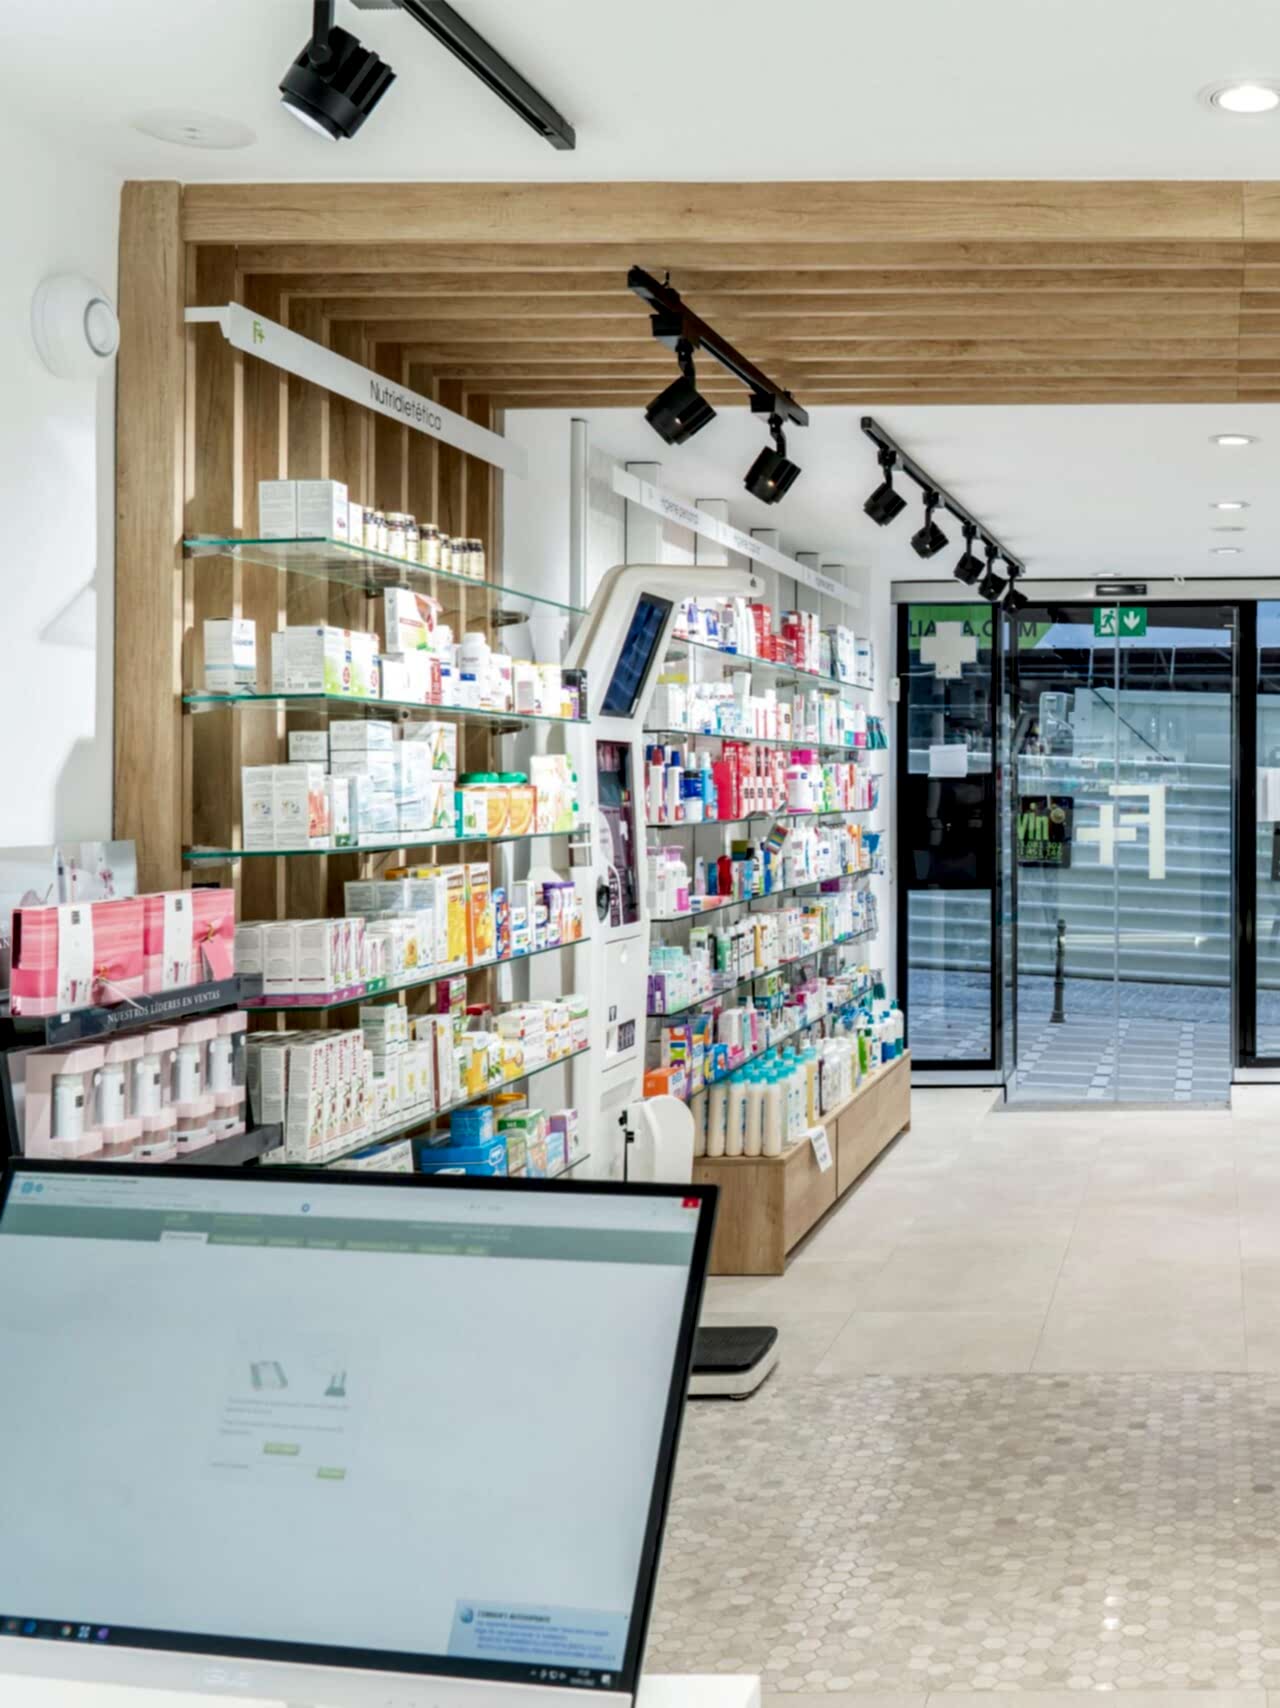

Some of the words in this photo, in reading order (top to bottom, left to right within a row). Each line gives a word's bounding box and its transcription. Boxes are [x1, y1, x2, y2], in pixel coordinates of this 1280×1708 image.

[369, 379, 442, 431] Nutridietética
[107, 1005, 149, 1024] NUESTROS
[151, 998, 181, 1015] LÍDERES
[182, 996, 192, 1007] EN
[194, 990, 221, 1004] VENTAS
